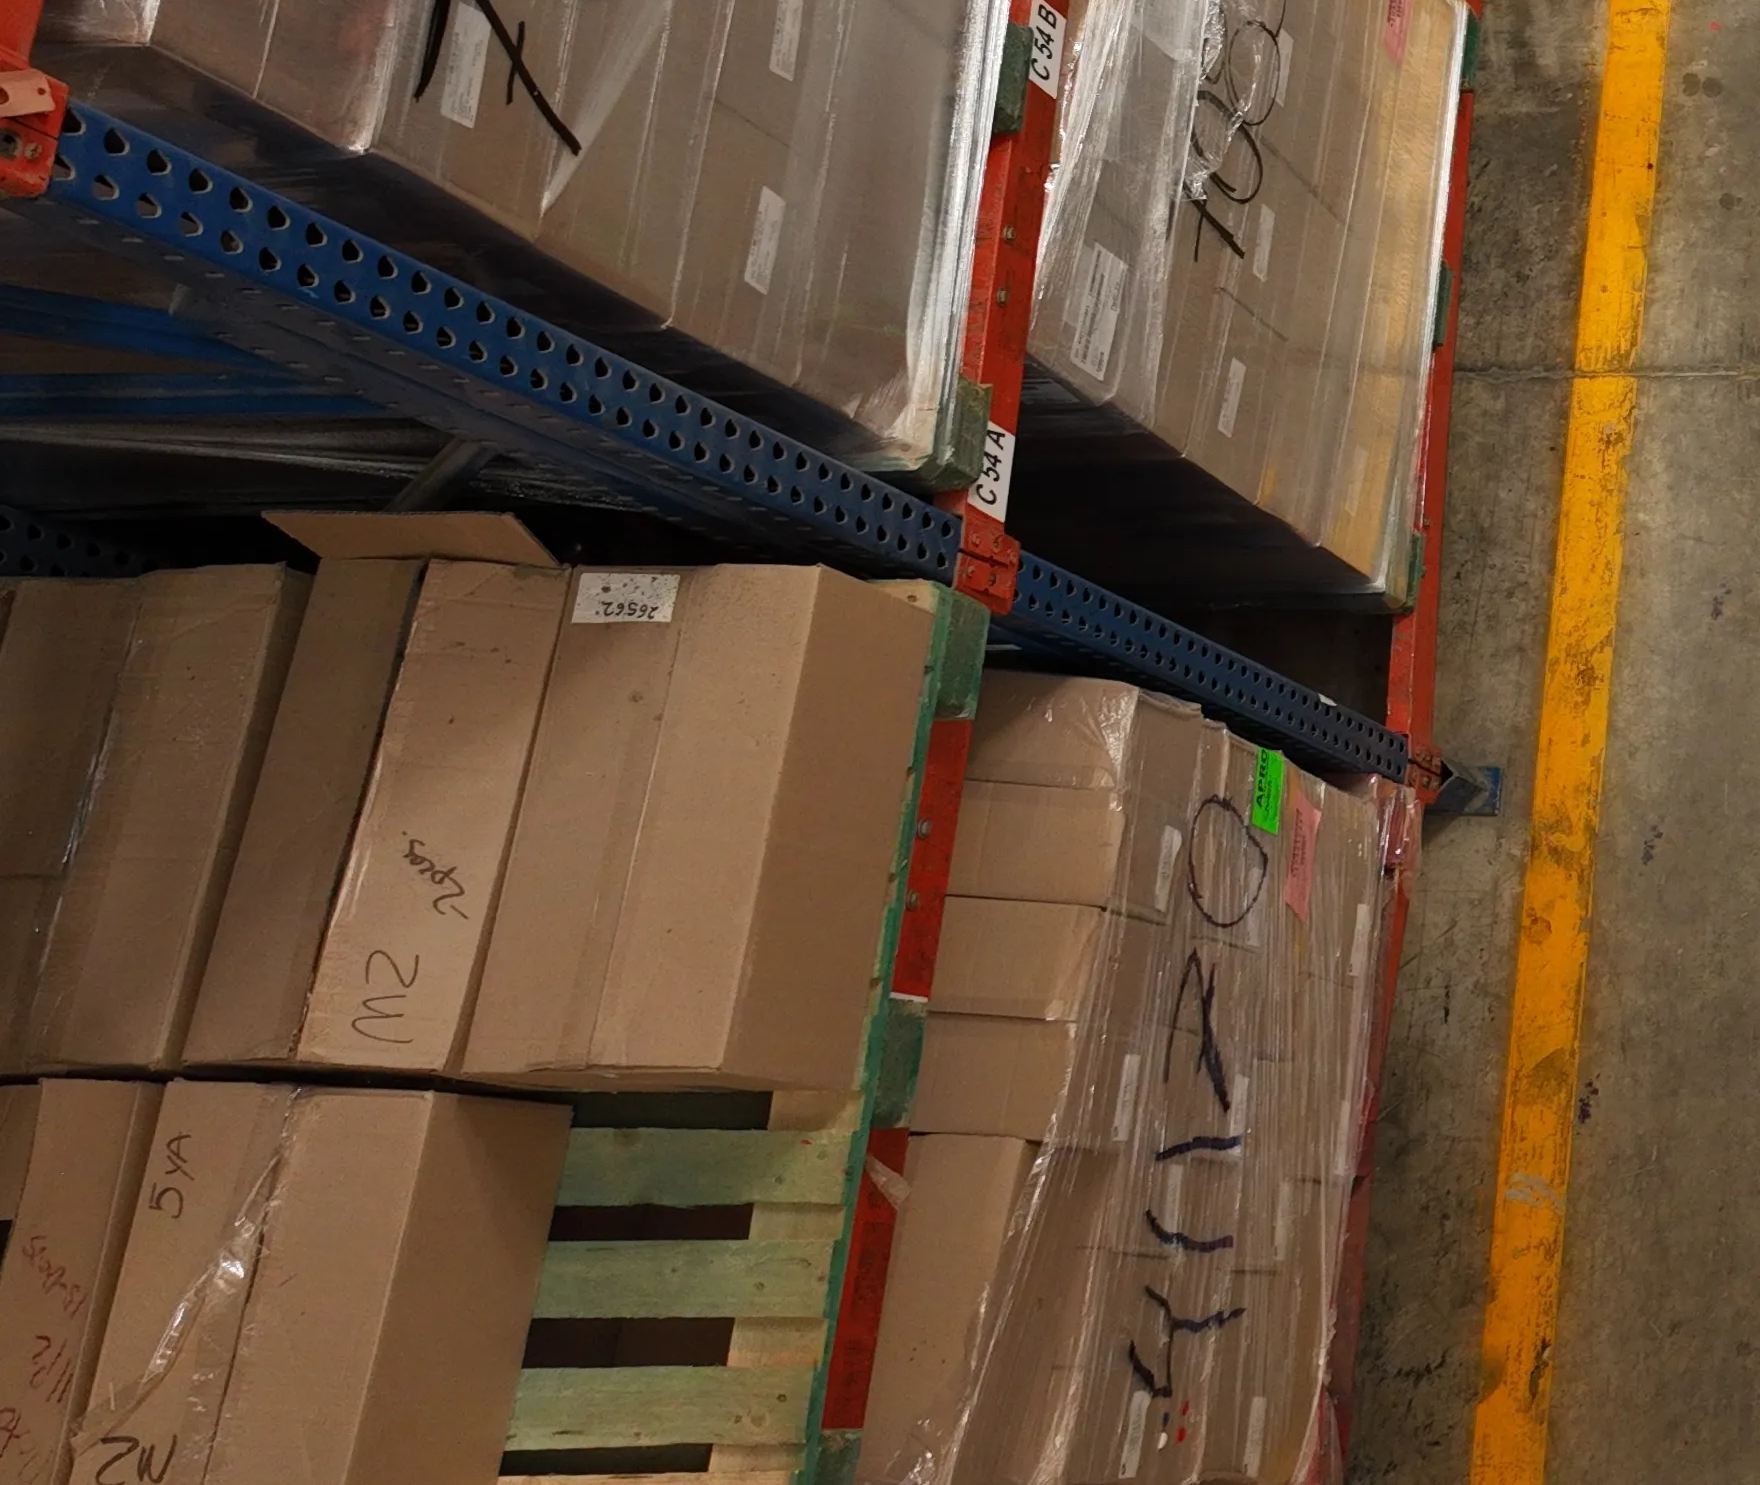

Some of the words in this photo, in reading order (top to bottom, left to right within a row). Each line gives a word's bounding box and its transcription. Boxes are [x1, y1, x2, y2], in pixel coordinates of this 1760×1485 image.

[1038, 3, 1058, 29] B
[1034, 26, 1054, 61] 54
[987, 428, 1006, 452] A
[982, 453, 1002, 485] 54
[976, 483, 997, 505] C
[601, 600, 659, 621] 26562
